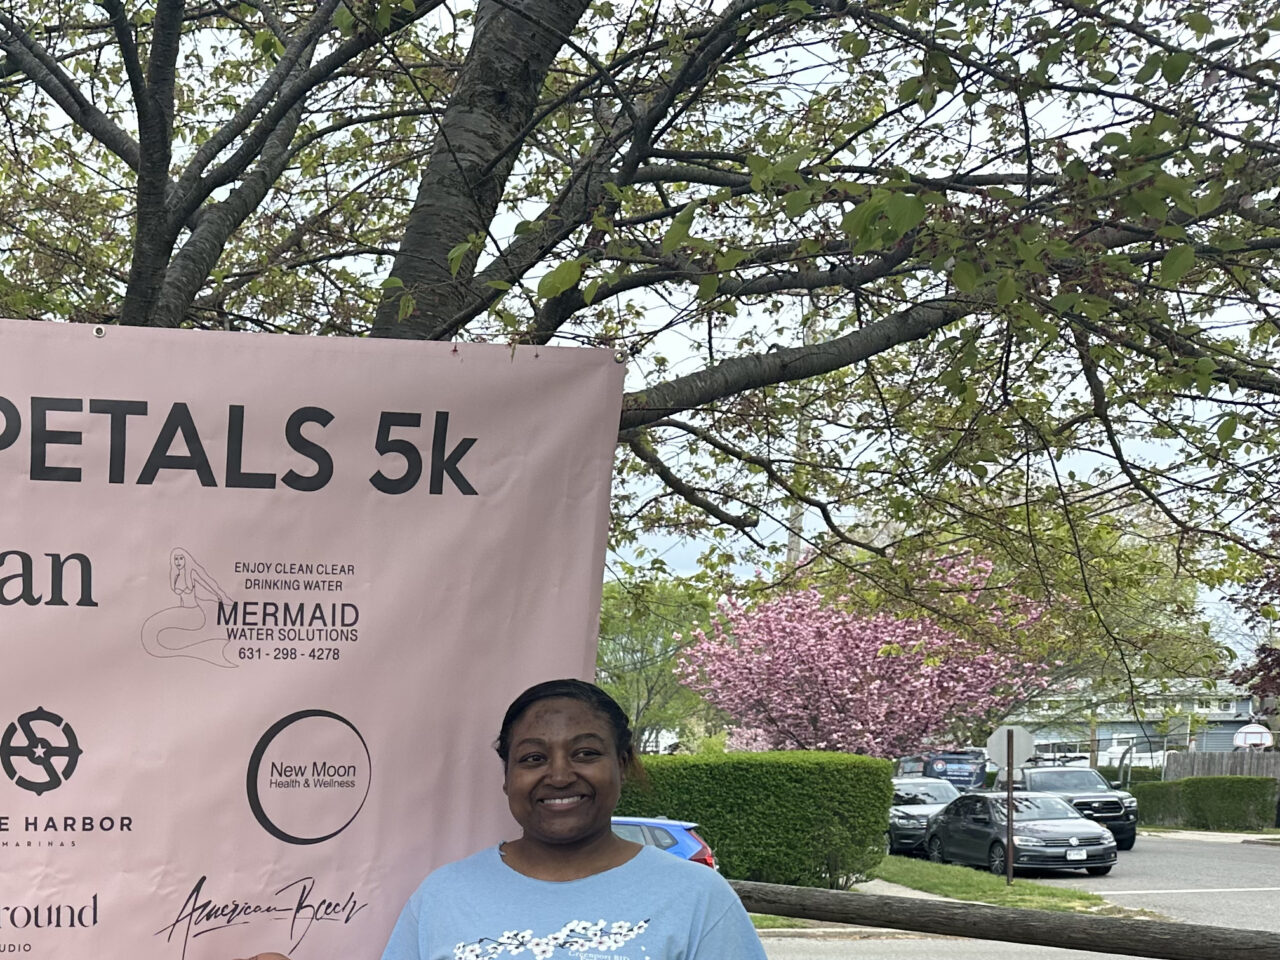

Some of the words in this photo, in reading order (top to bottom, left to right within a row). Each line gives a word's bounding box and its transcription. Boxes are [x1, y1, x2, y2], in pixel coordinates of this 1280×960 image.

[369, 411, 479, 496] 5k
[234, 561, 271, 574] ENJOY
[275, 563, 313, 575] CLEAN
[316, 564, 355, 576] CLEAR
[245, 578, 300, 591] DRINKING
[303, 580, 343, 591] WATER
[217, 601, 359, 627] MERMAID
[226, 628, 274, 640] WATER
[278, 628, 358, 641] SOLUTIONS
[238, 648, 261, 660] 631
[273, 648, 297, 660] 298
[309, 648, 340, 660] 4278
[269, 761, 306, 779] New
[312, 761, 356, 779] Moon
[269, 778, 303, 788] Health
[304, 778, 311, 787] &
[314, 777, 356, 788] Wellness
[24, 816, 133, 832] HARBOR
